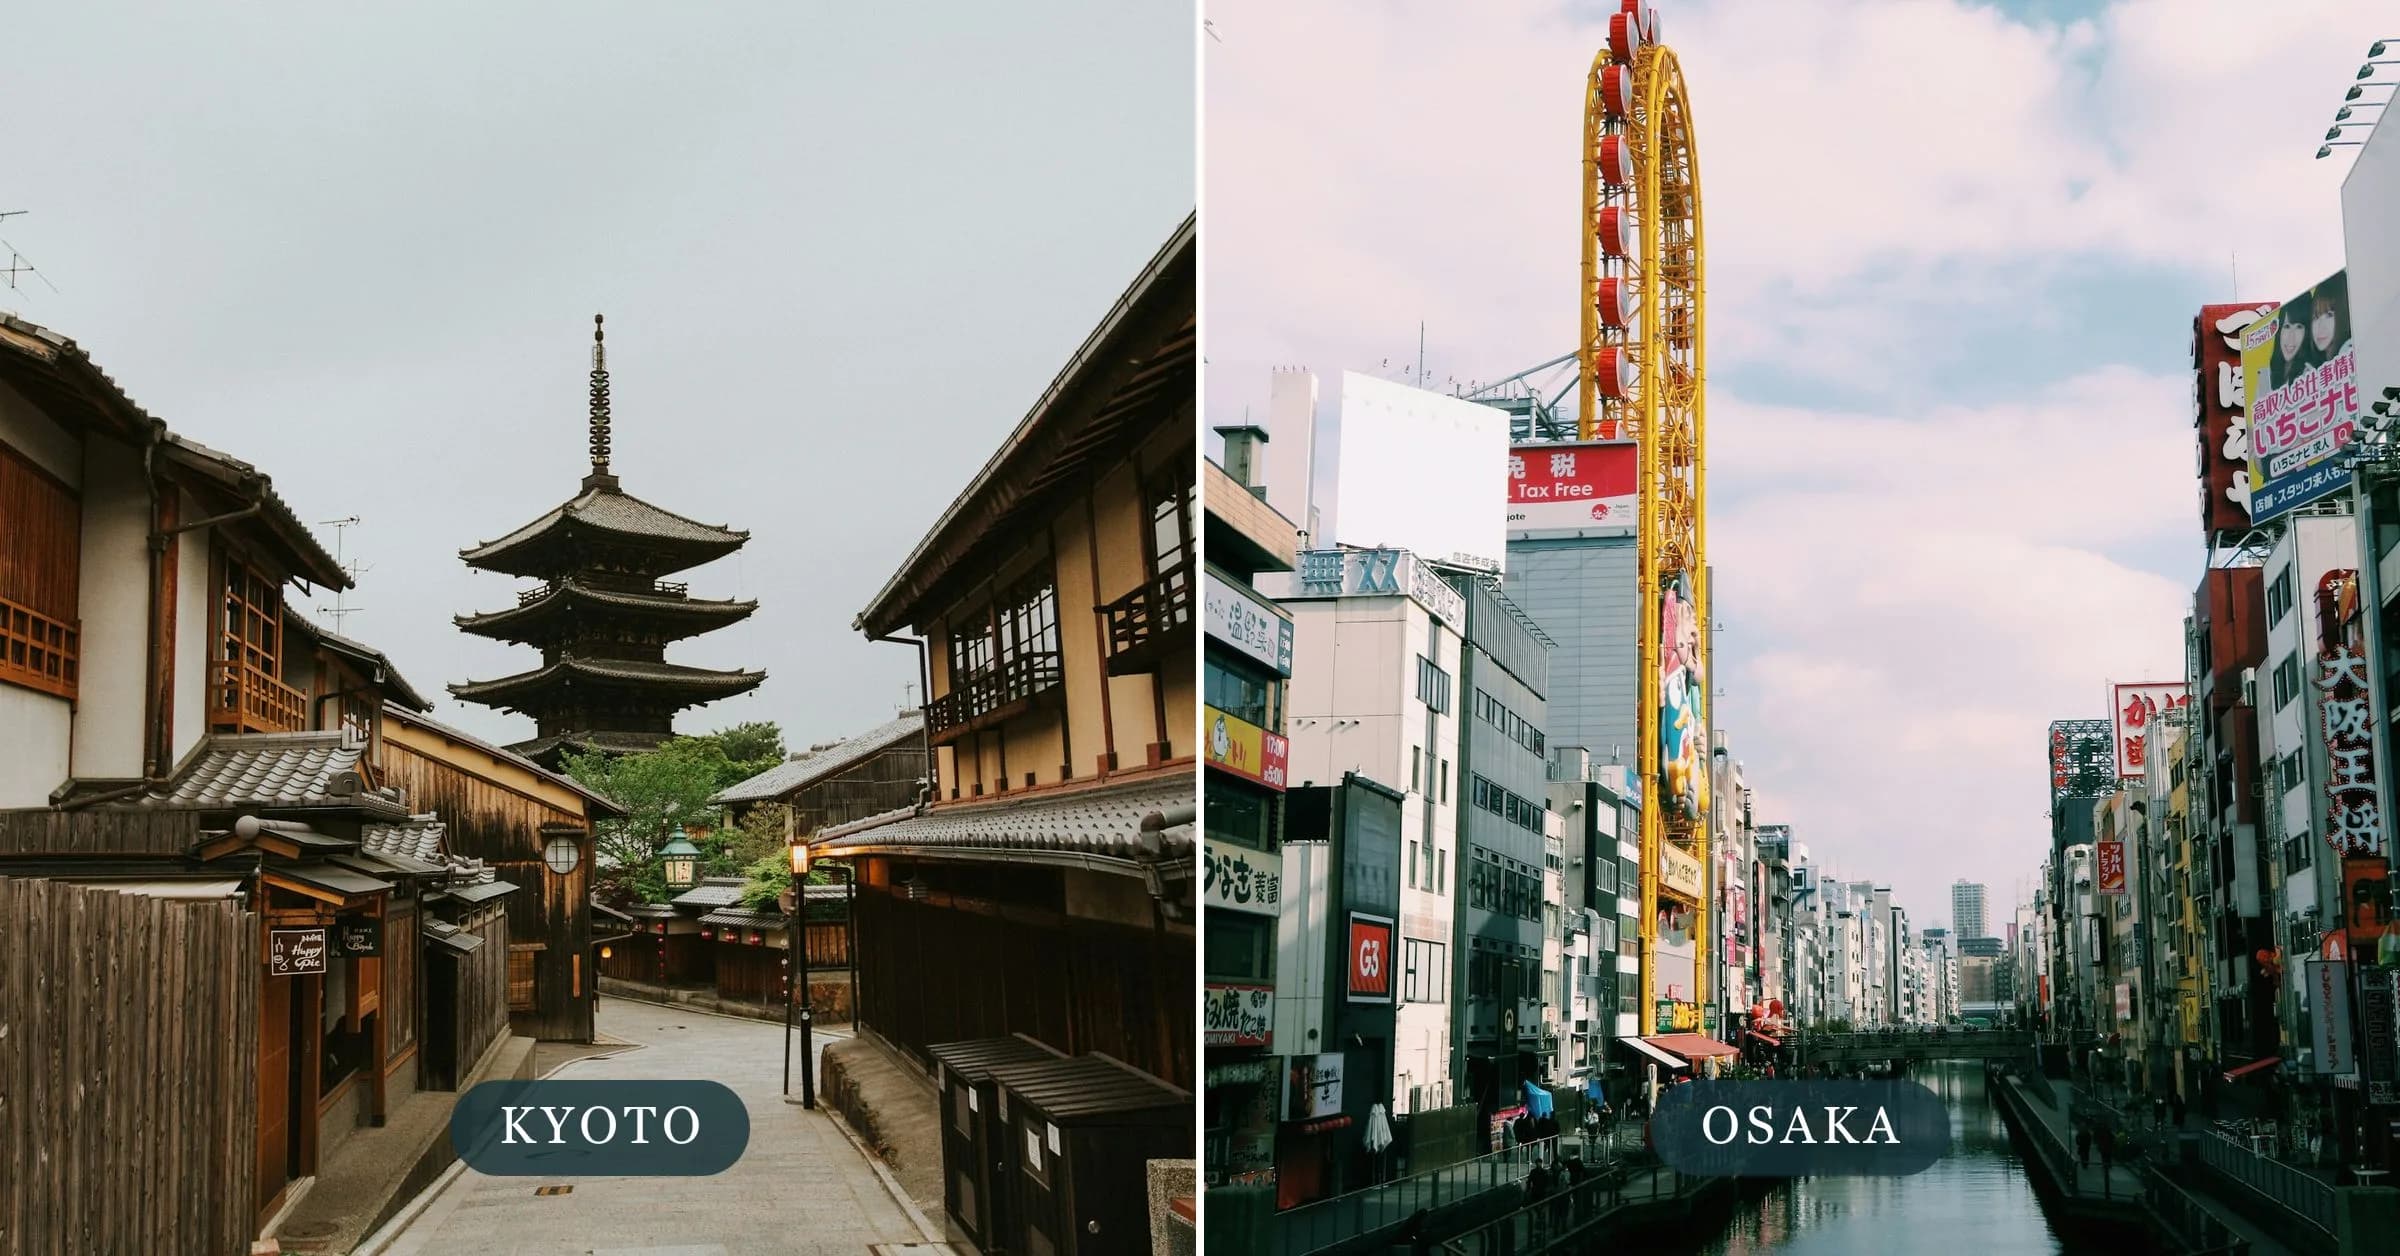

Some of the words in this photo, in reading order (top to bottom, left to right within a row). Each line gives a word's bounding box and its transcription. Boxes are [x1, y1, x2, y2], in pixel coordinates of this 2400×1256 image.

[1518, 483, 1549, 498] Tax
[1555, 482, 1593, 497] Free
[2312, 646, 2379, 854] 大阪王将
[2110, 844, 2122, 873] ツルハ
[291, 940, 322, 958] Happy
[1360, 939, 1380, 977] G3
